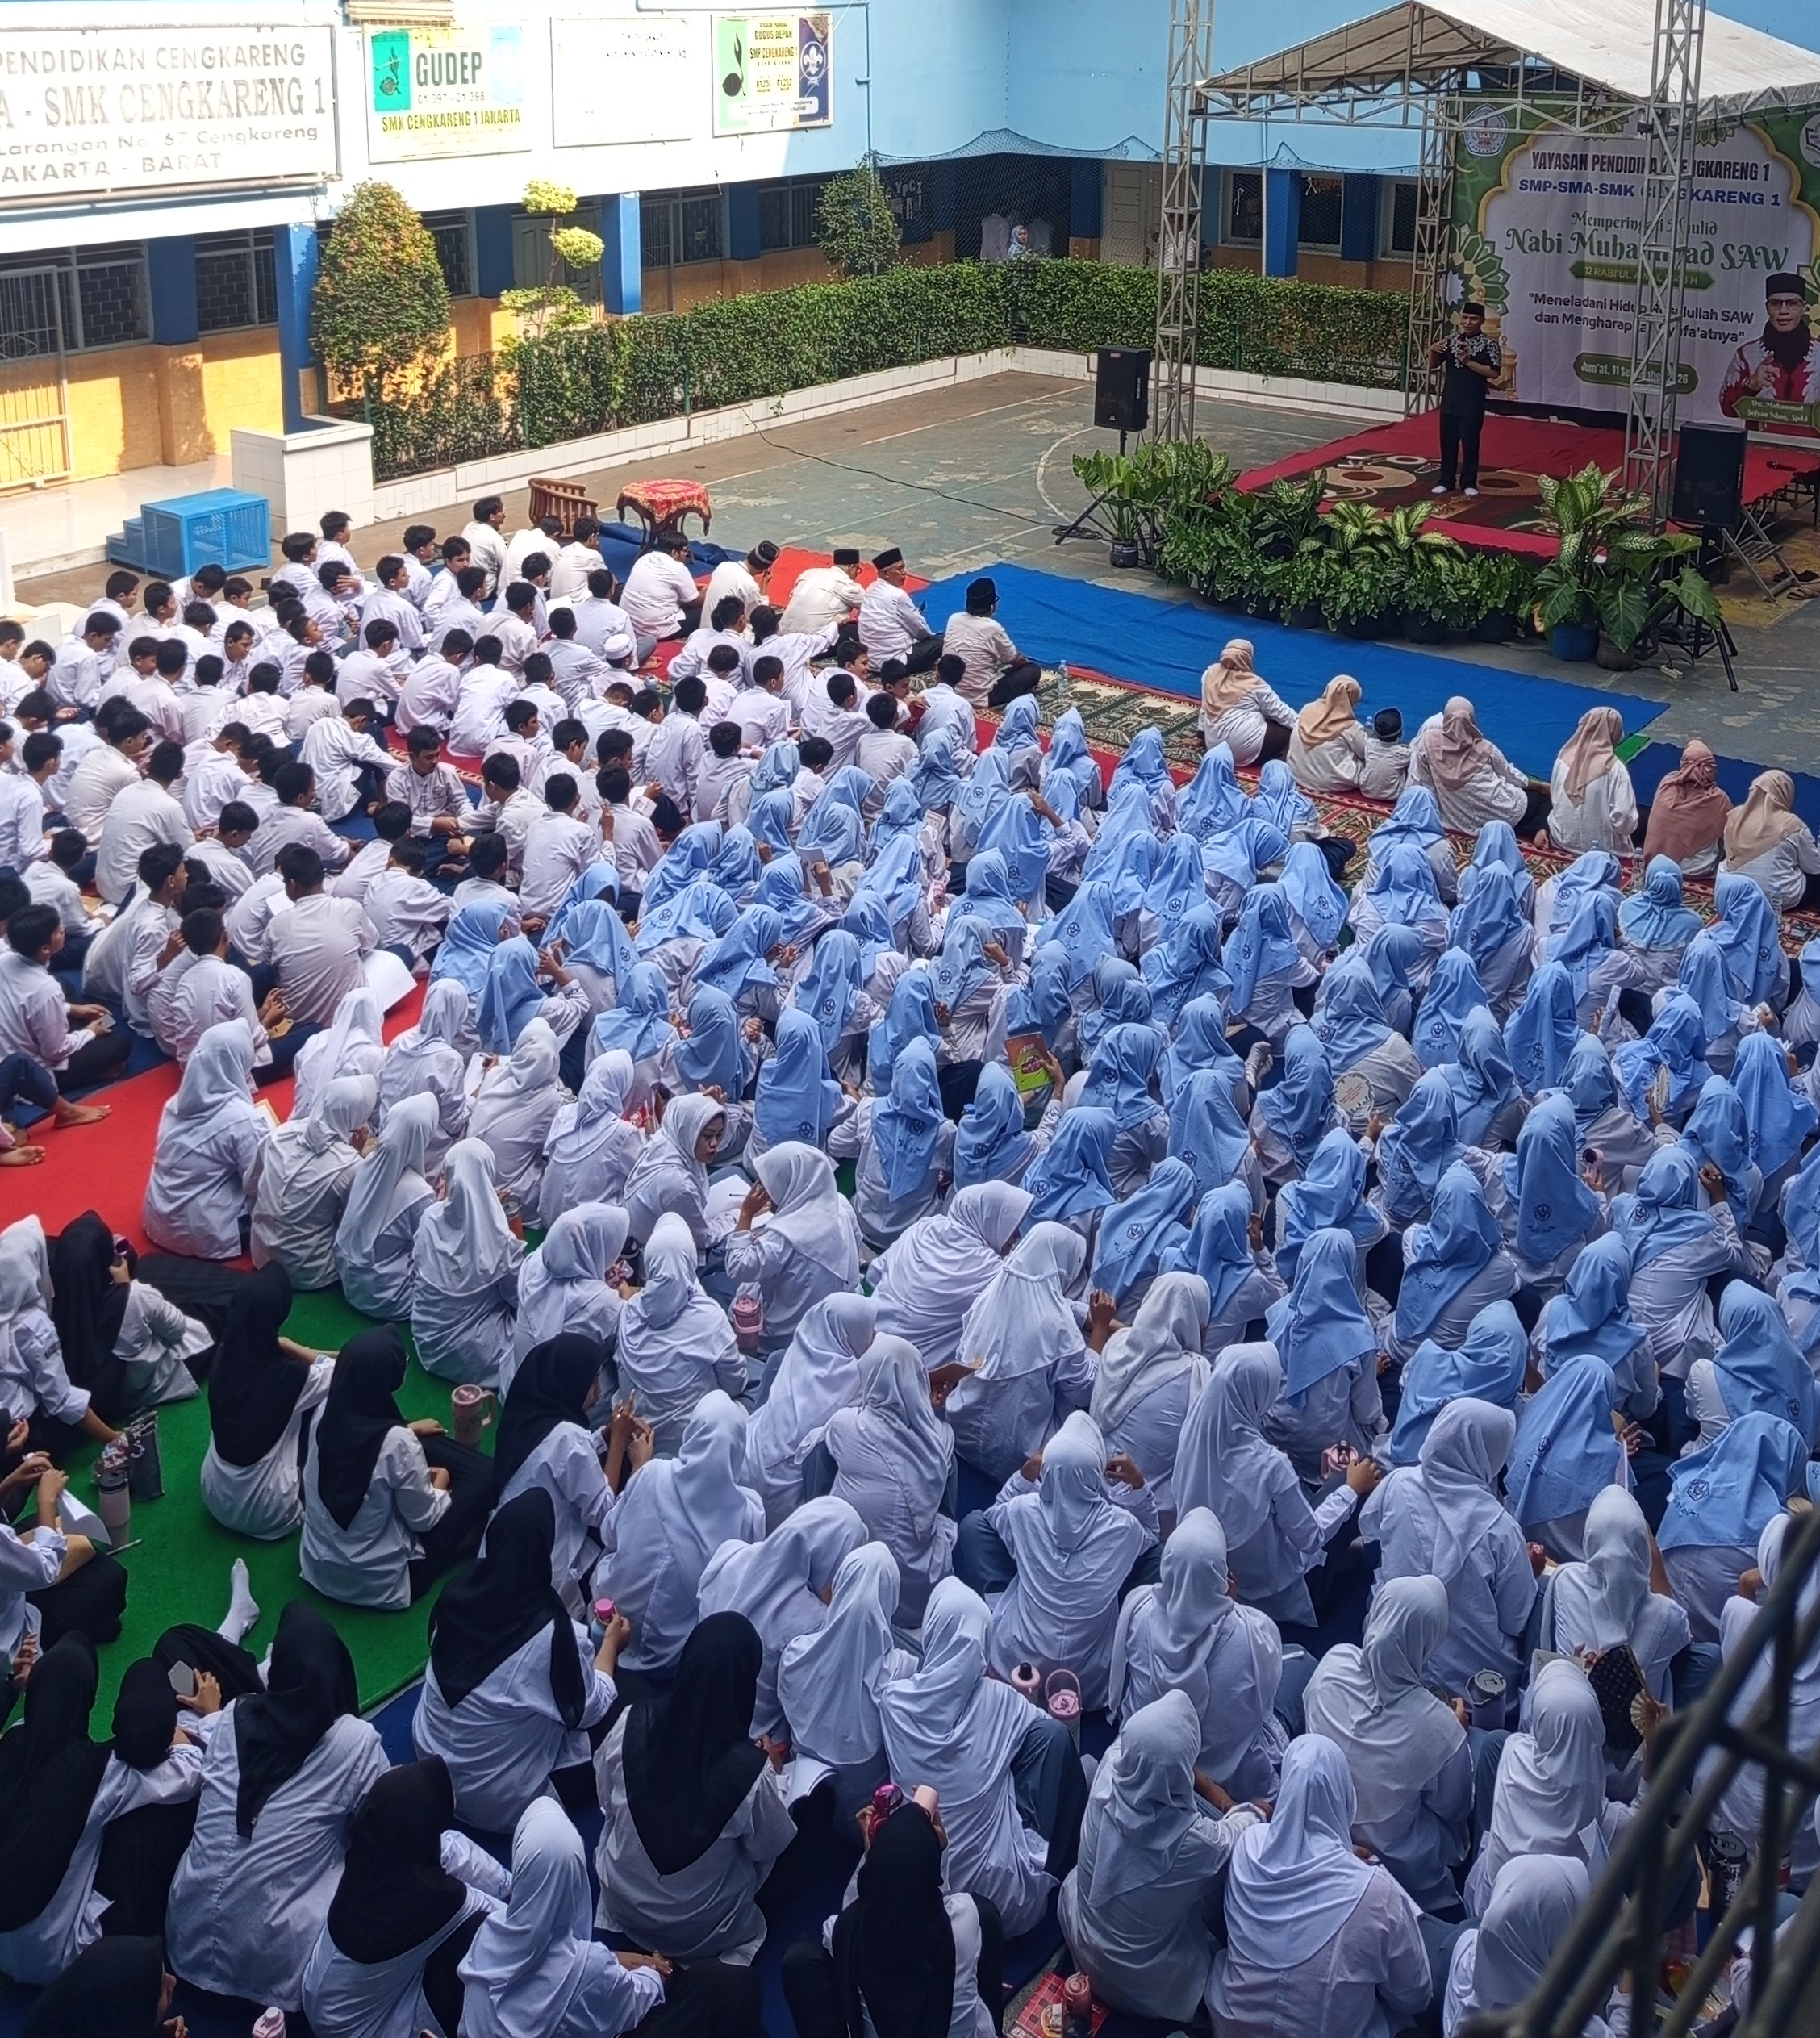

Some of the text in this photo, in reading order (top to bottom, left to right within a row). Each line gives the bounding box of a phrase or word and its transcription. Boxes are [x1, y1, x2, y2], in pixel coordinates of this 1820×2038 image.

[0, 43, 306, 75] ENDIDIKAN CENGKARENG
[415, 51, 483, 87] GUDEP
[44, 84, 110, 127] SMK
[119, 77, 304, 124] CENGKARENG
[314, 77, 326, 115] 1
[382, 108, 521, 132] SMK CENGKARENG 1 JAKARTA
[196, 126, 319, 146] Cengkareng
[141, 152, 222, 173] BARAT
[1532, 152, 1588, 172] YAYASAN
[1763, 163, 1771, 182] 1
[1518, 178, 1636, 198] SMP-SMA-SMK
[1771, 193, 1781, 207] 1
[1505, 228, 1789, 272] Nabi Muhaad SAW
[1584, 266, 1592, 275] 12
[1534, 311, 1559, 324] dan
[1720, 310, 1755, 324] SAW
[1612, 365, 1620, 376] 11
